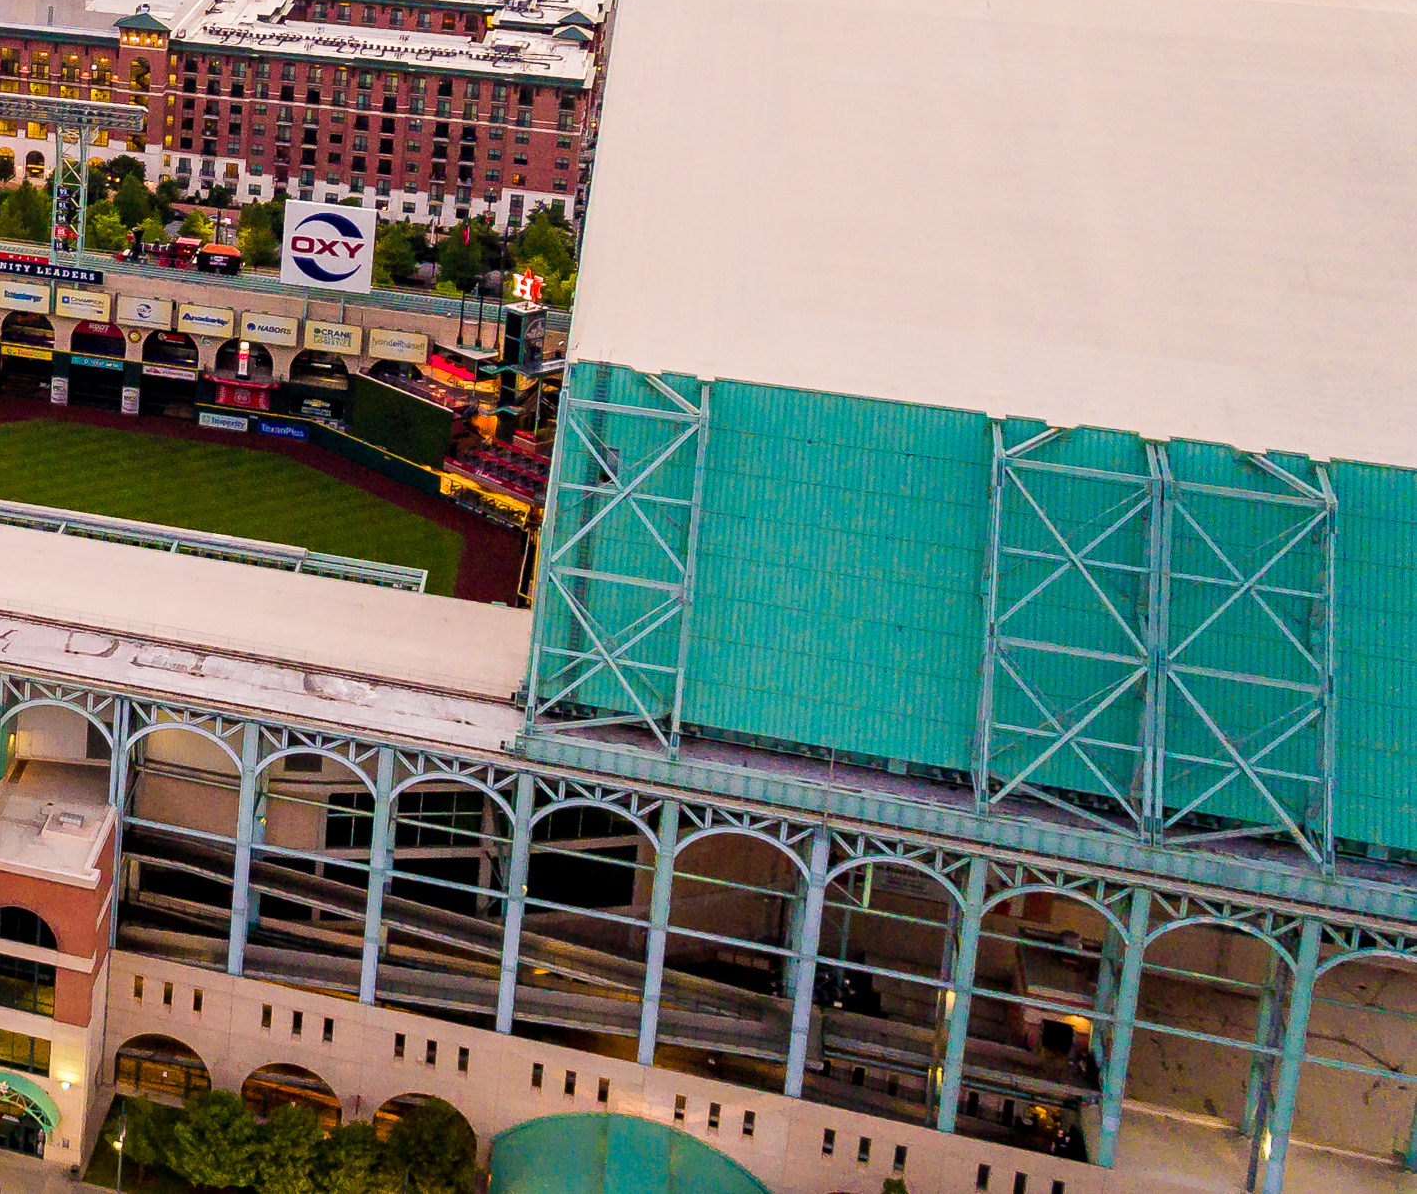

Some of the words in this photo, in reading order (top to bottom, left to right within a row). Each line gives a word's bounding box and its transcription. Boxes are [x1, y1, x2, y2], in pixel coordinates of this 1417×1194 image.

[291, 235, 365, 259] OXY
[36, 266, 95, 281] LEADERS
[70, 296, 105, 305] CHAMPION
[257, 324, 292, 335] NABORS
[321, 328, 352, 338] CRANE
[261, 424, 305, 437] TexanPlus
